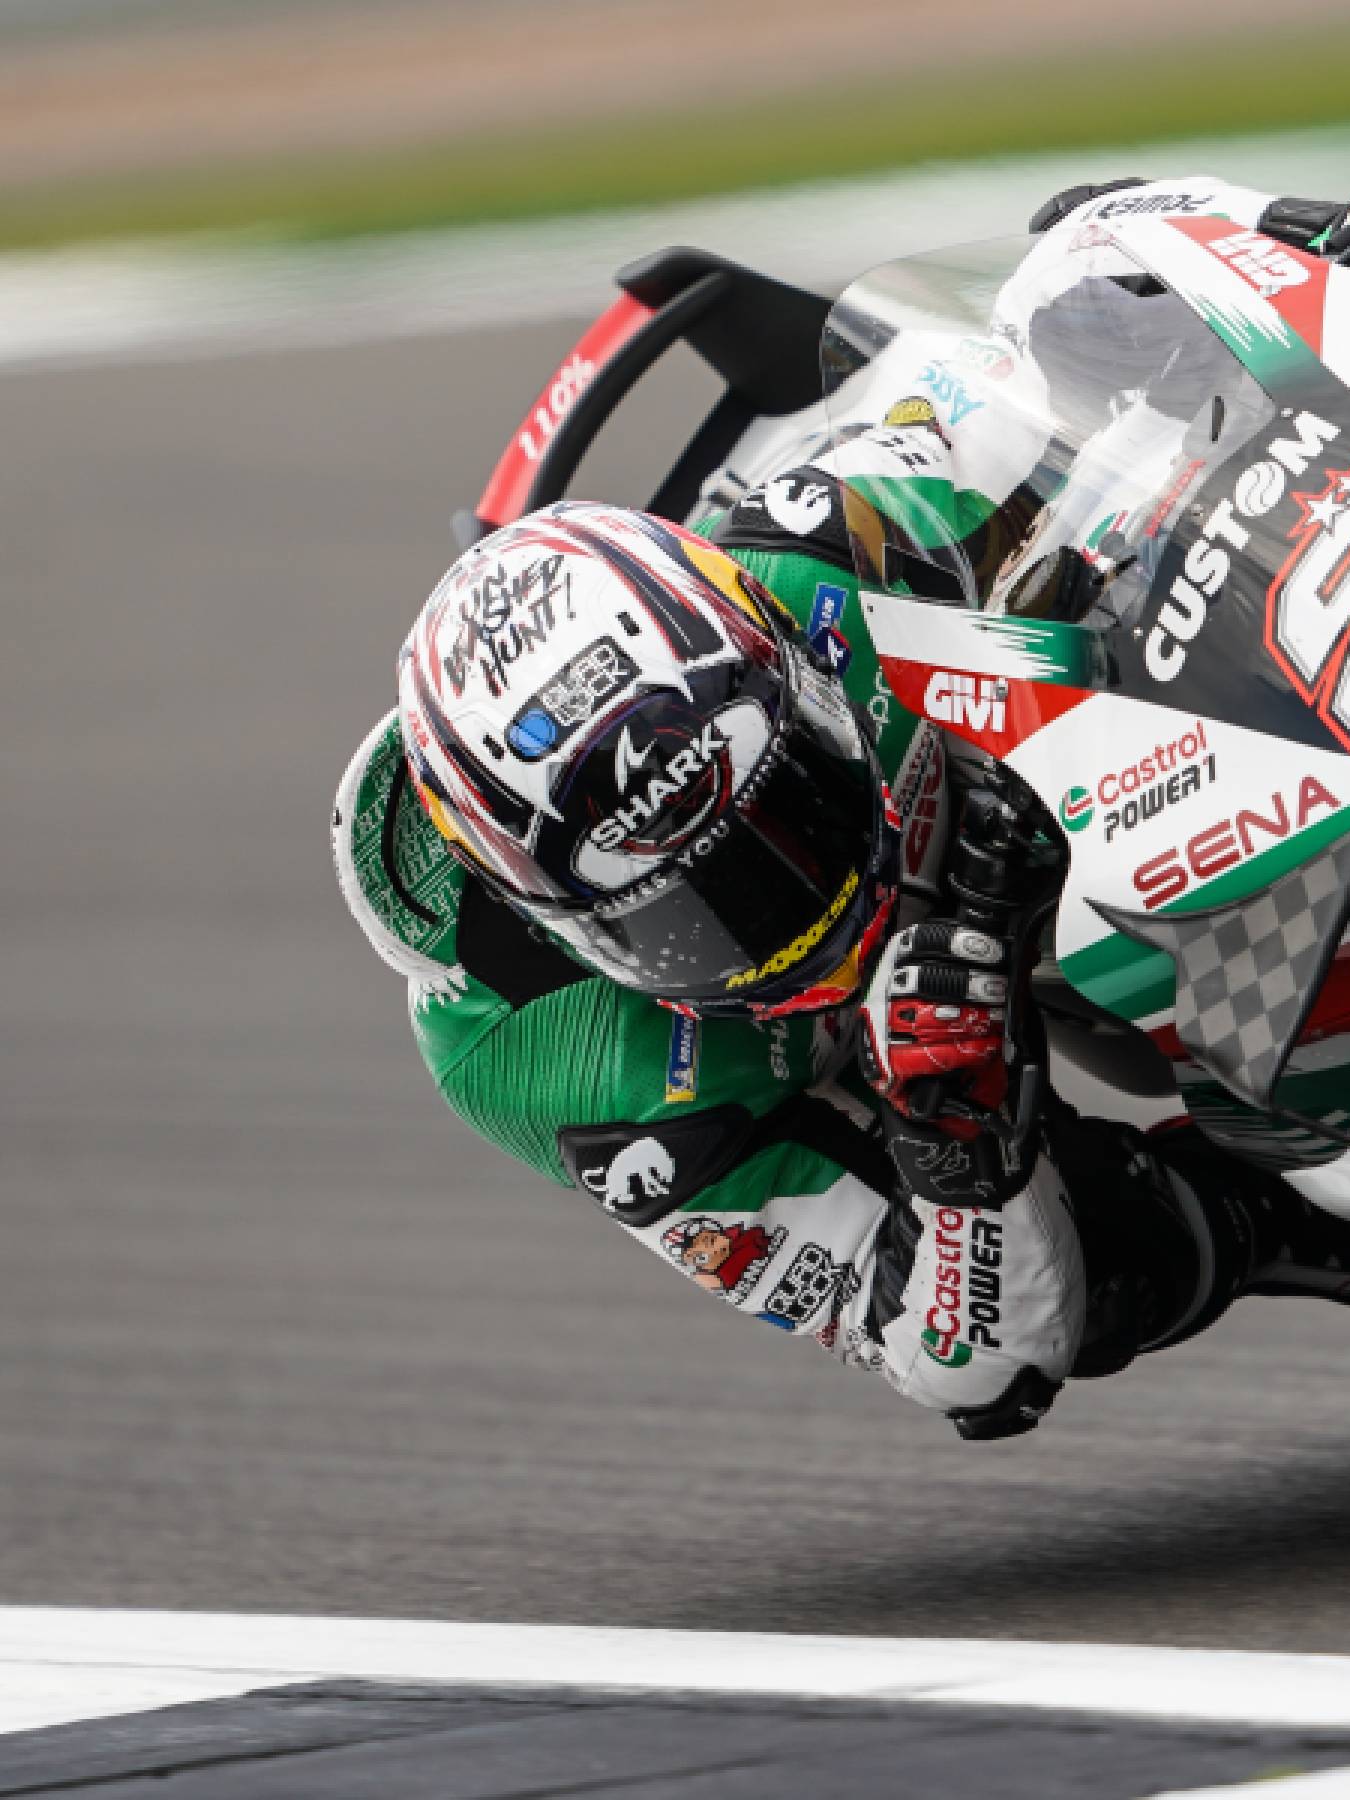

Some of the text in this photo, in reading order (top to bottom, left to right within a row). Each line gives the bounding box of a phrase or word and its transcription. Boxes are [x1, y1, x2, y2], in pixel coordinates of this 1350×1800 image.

[924, 672, 1008, 732] GIVI
[589, 726, 728, 850] SHARK
[1098, 721, 1208, 805] Castrol
[1104, 754, 1216, 842] POWER1
[676, 817, 729, 865] YOU
[1133, 776, 1340, 909] SENA
[926, 1206, 963, 1339] Castro
[969, 1207, 1002, 1348] POWER
